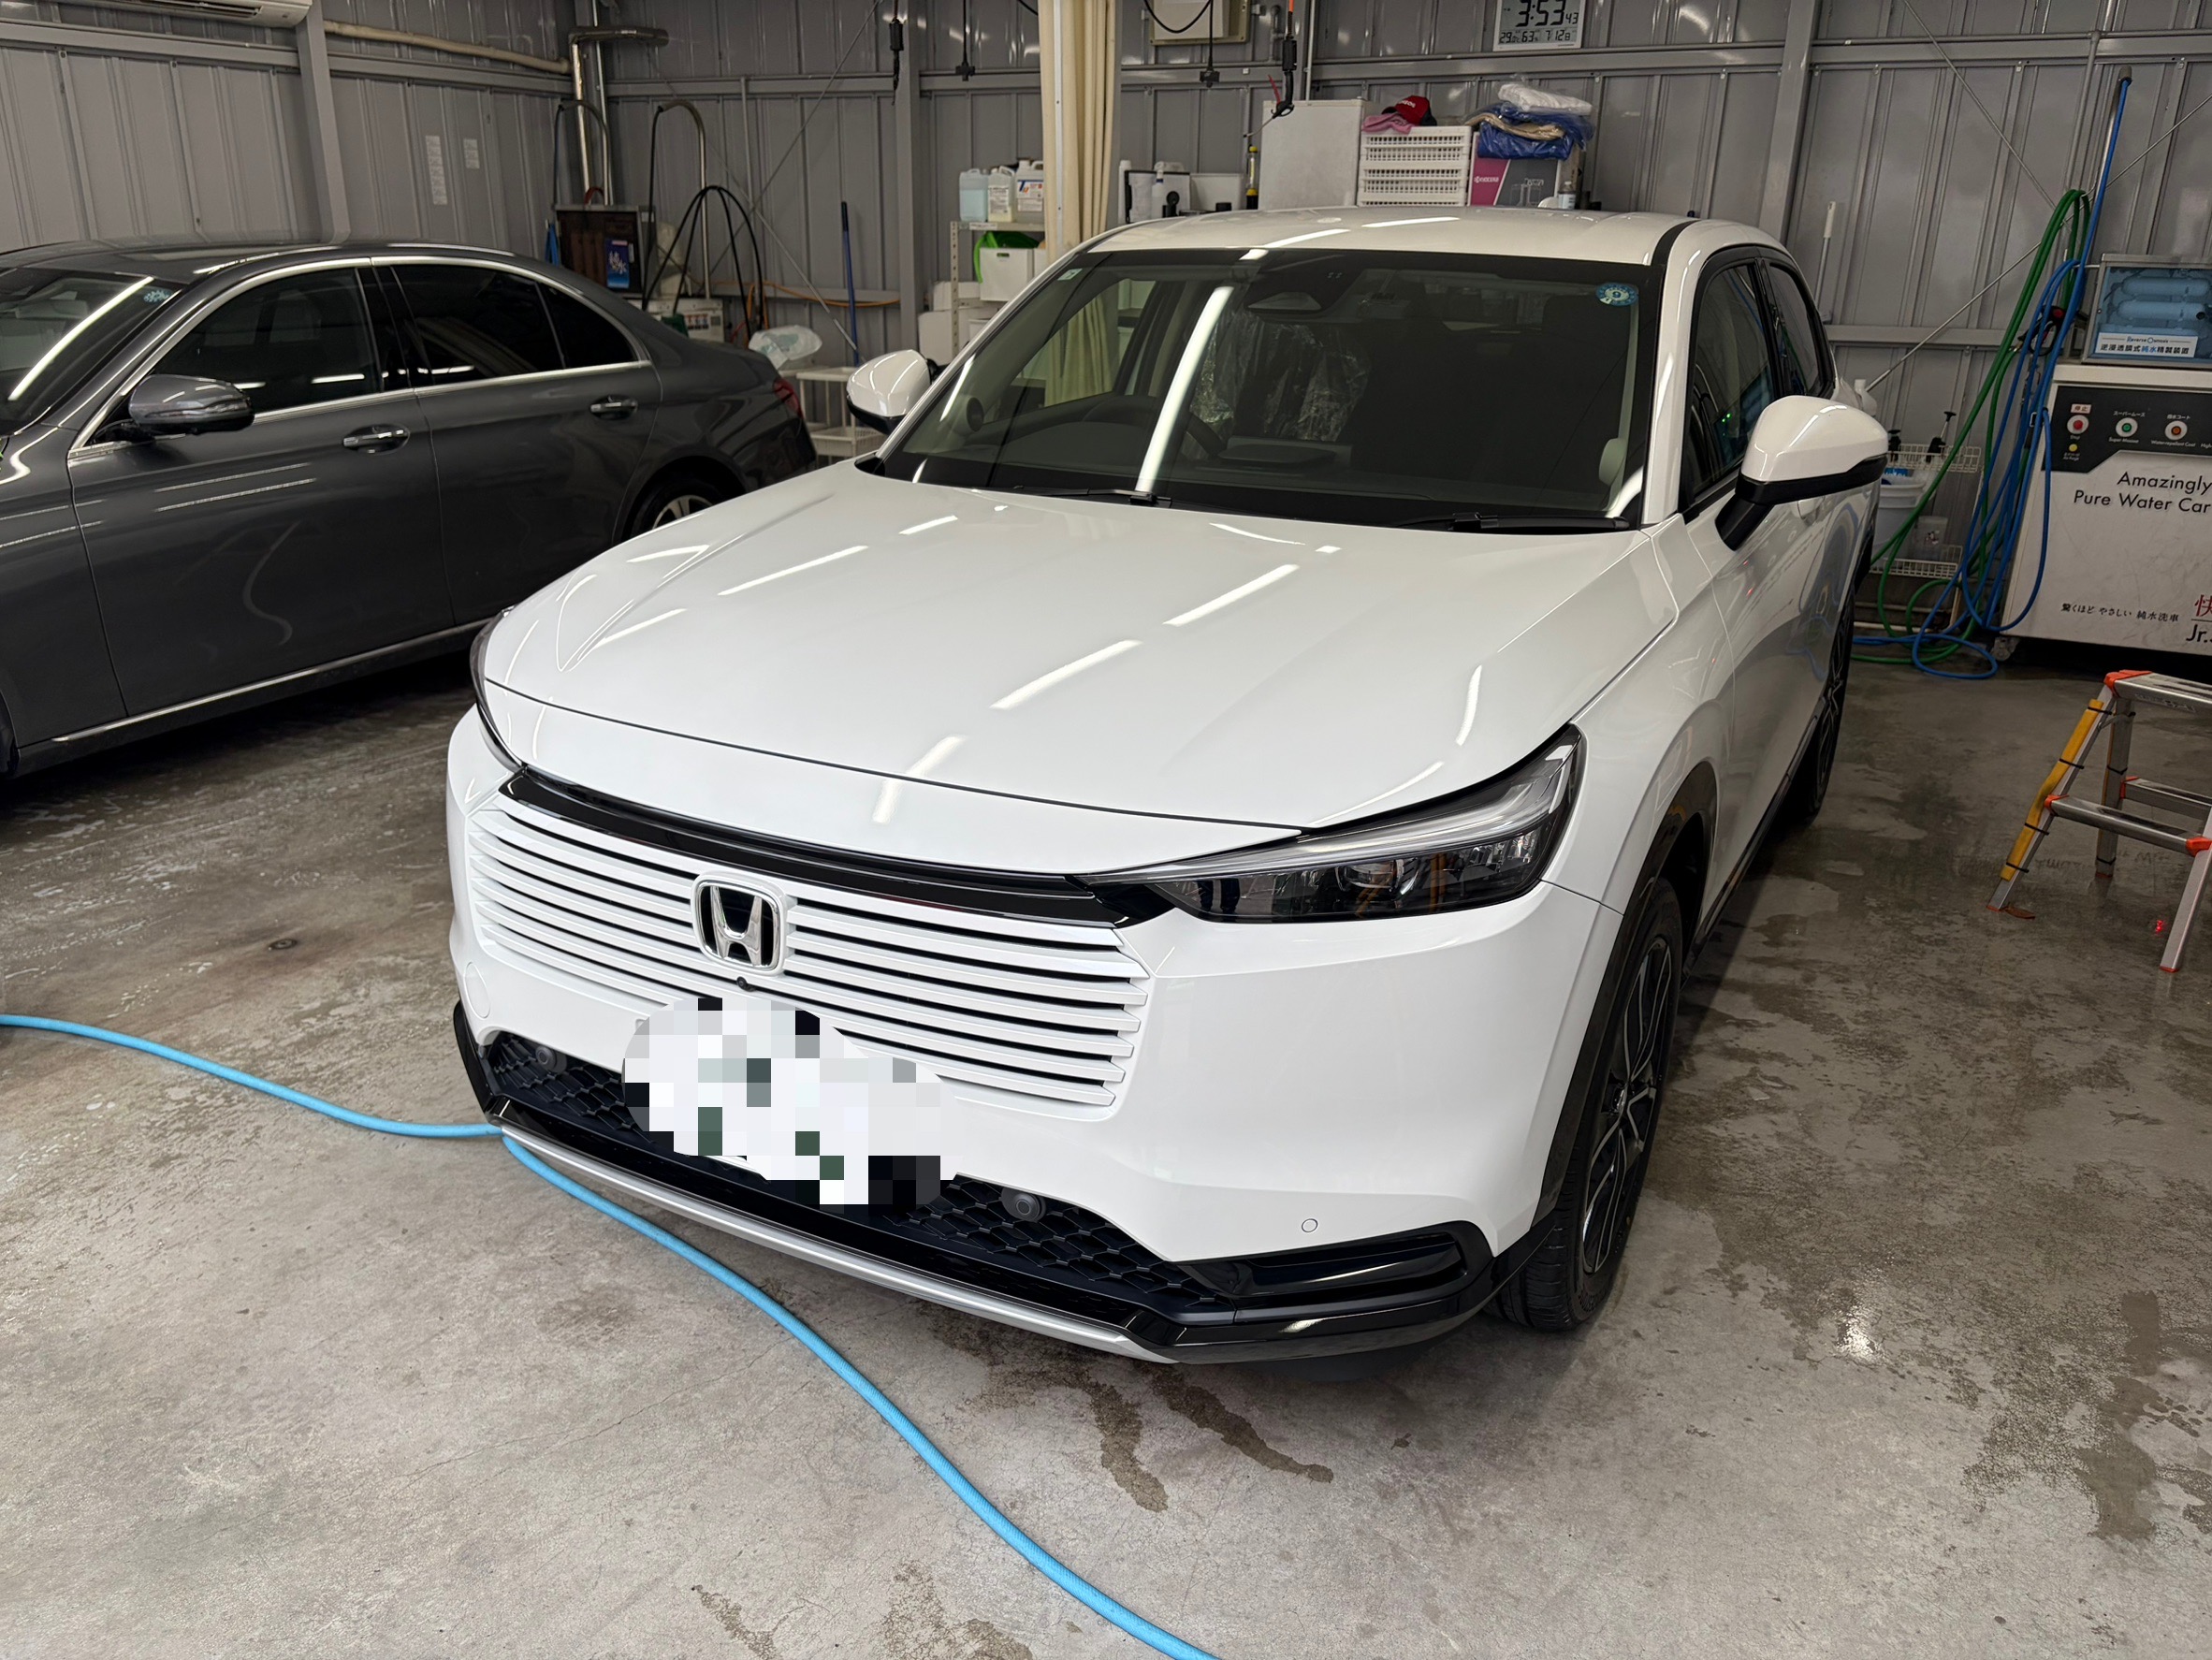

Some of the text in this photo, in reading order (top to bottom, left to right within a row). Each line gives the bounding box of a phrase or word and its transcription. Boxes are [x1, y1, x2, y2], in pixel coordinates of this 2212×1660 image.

[1515, 0, 1579, 27] 3:53 43
[2117, 471, 2212, 496] Amazingly
[2074, 489, 2211, 514] Pure Water Car
[2099, 607, 2132, 617] やさしい
[2136, 610, 2179, 622] 純水洗車
[2186, 624, 2212, 643] Jr.
